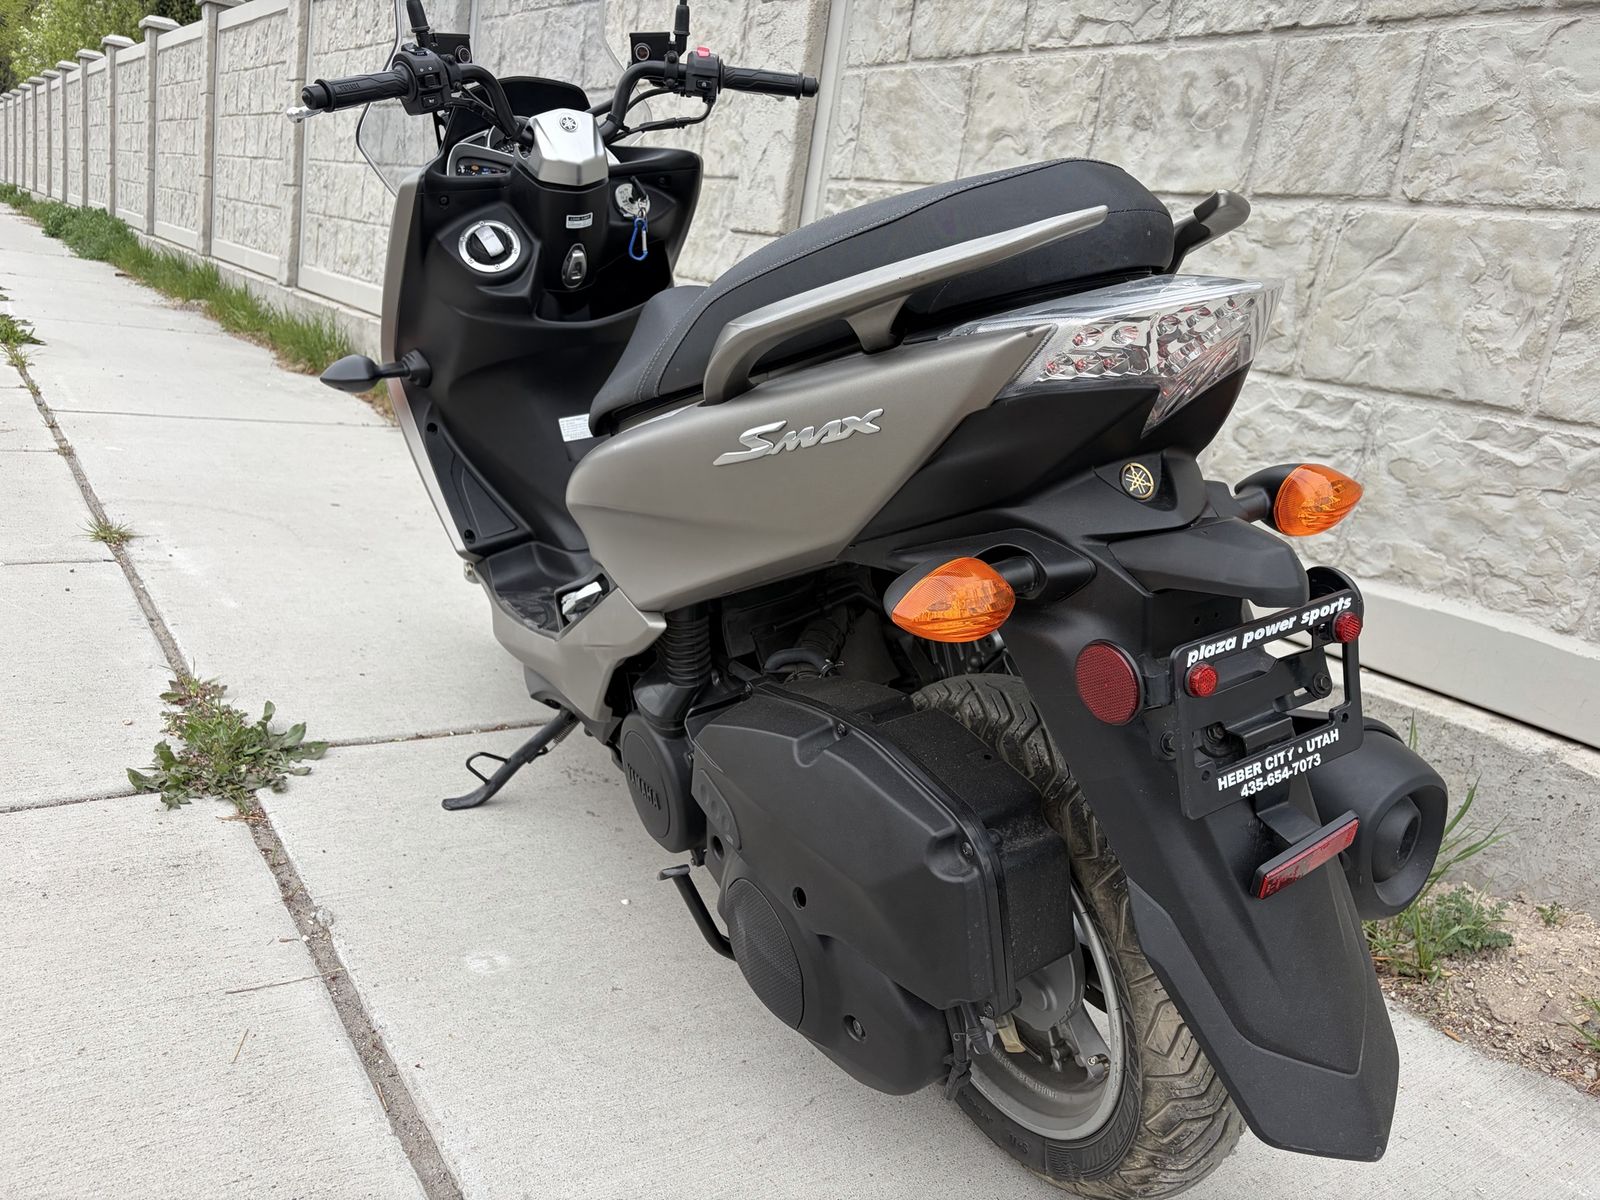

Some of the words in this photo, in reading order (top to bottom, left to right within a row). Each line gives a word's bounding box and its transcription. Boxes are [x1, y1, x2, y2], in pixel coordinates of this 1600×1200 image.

[1186, 636, 1237, 667] plaza
[1242, 616, 1297, 649] power
[1301, 597, 1352, 626] sports
[1217, 762, 1262, 791] HEBER
[1265, 746, 1294, 770] CITY
[1306, 728, 1339, 752] UTAH
[1240, 753, 1321, 797] 435-654-7073
